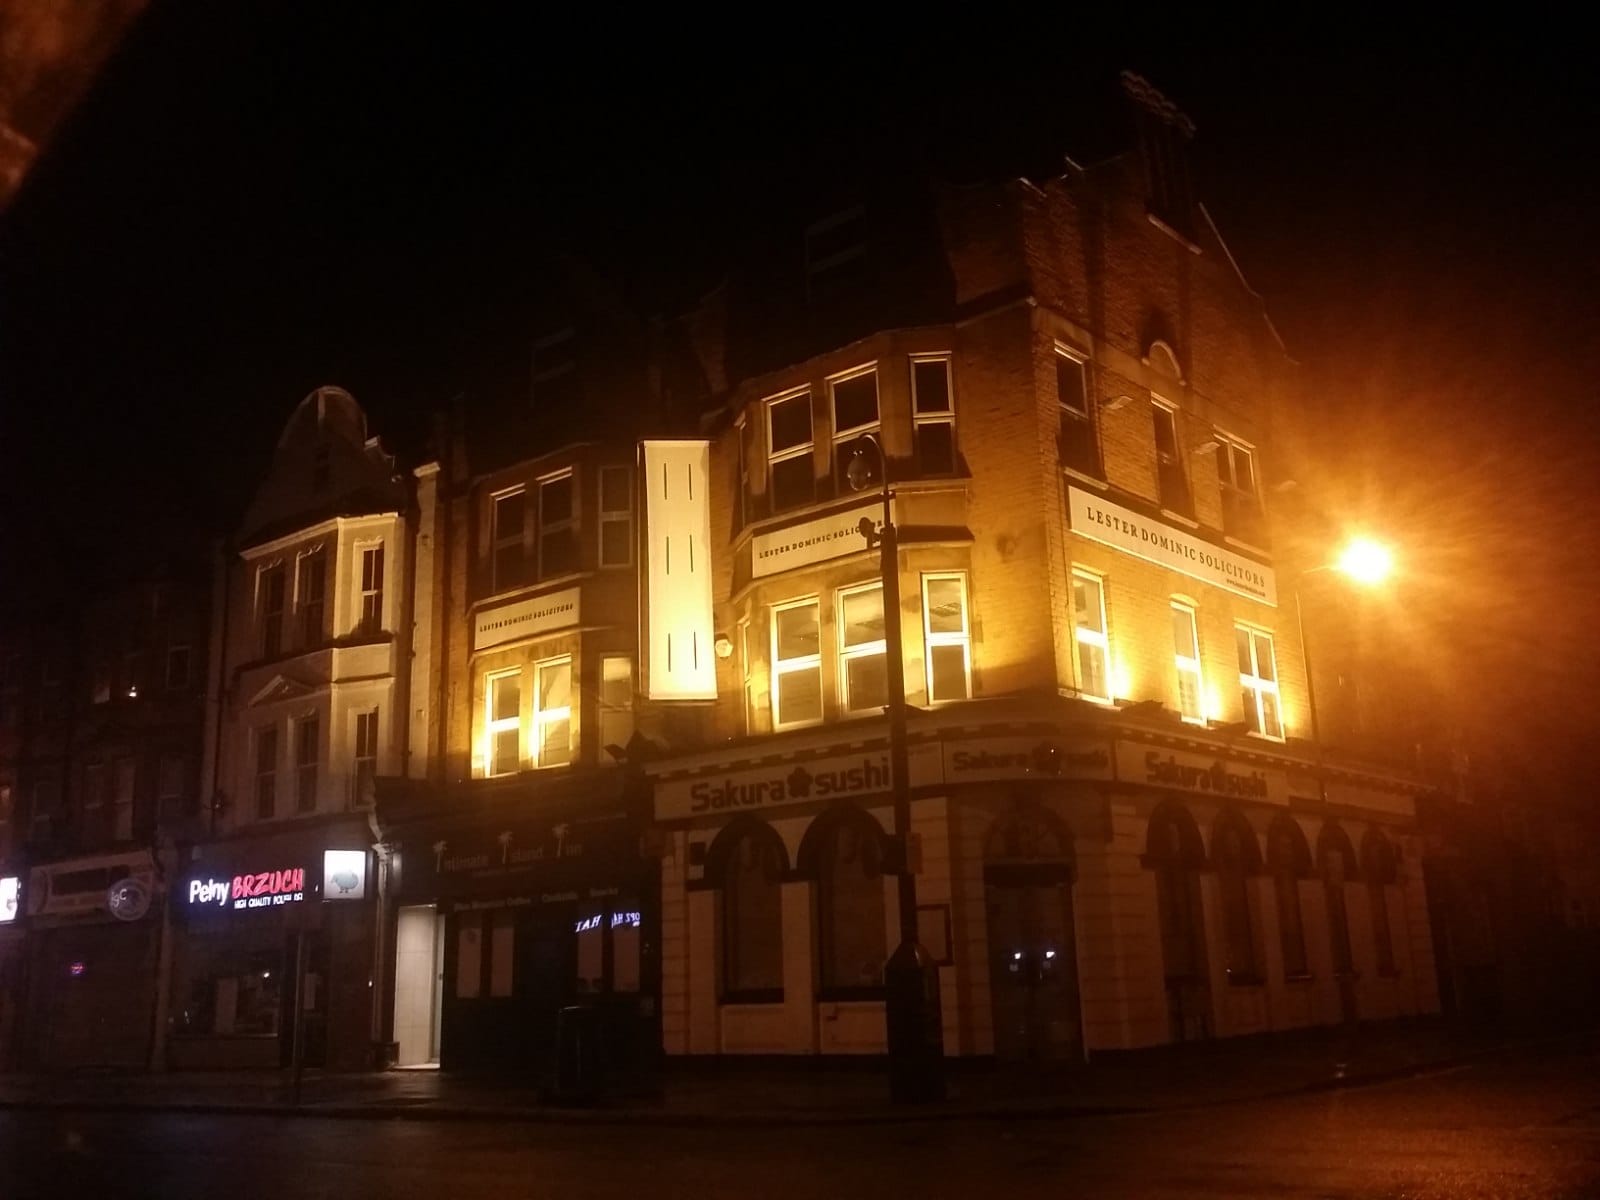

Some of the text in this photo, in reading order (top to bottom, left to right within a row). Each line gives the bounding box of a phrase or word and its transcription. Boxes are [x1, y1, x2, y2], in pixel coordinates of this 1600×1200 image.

[792, 534, 831, 550] DOMINIC
[1087, 507, 1138, 538] LESTER
[1141, 528, 1196, 560] DOMINIC
[1199, 552, 1265, 588] SOLICITORS
[690, 757, 889, 813] Sakura sushi
[231, 868, 304, 899] BRZUCH
[248, 896, 271, 908] QUALITY
